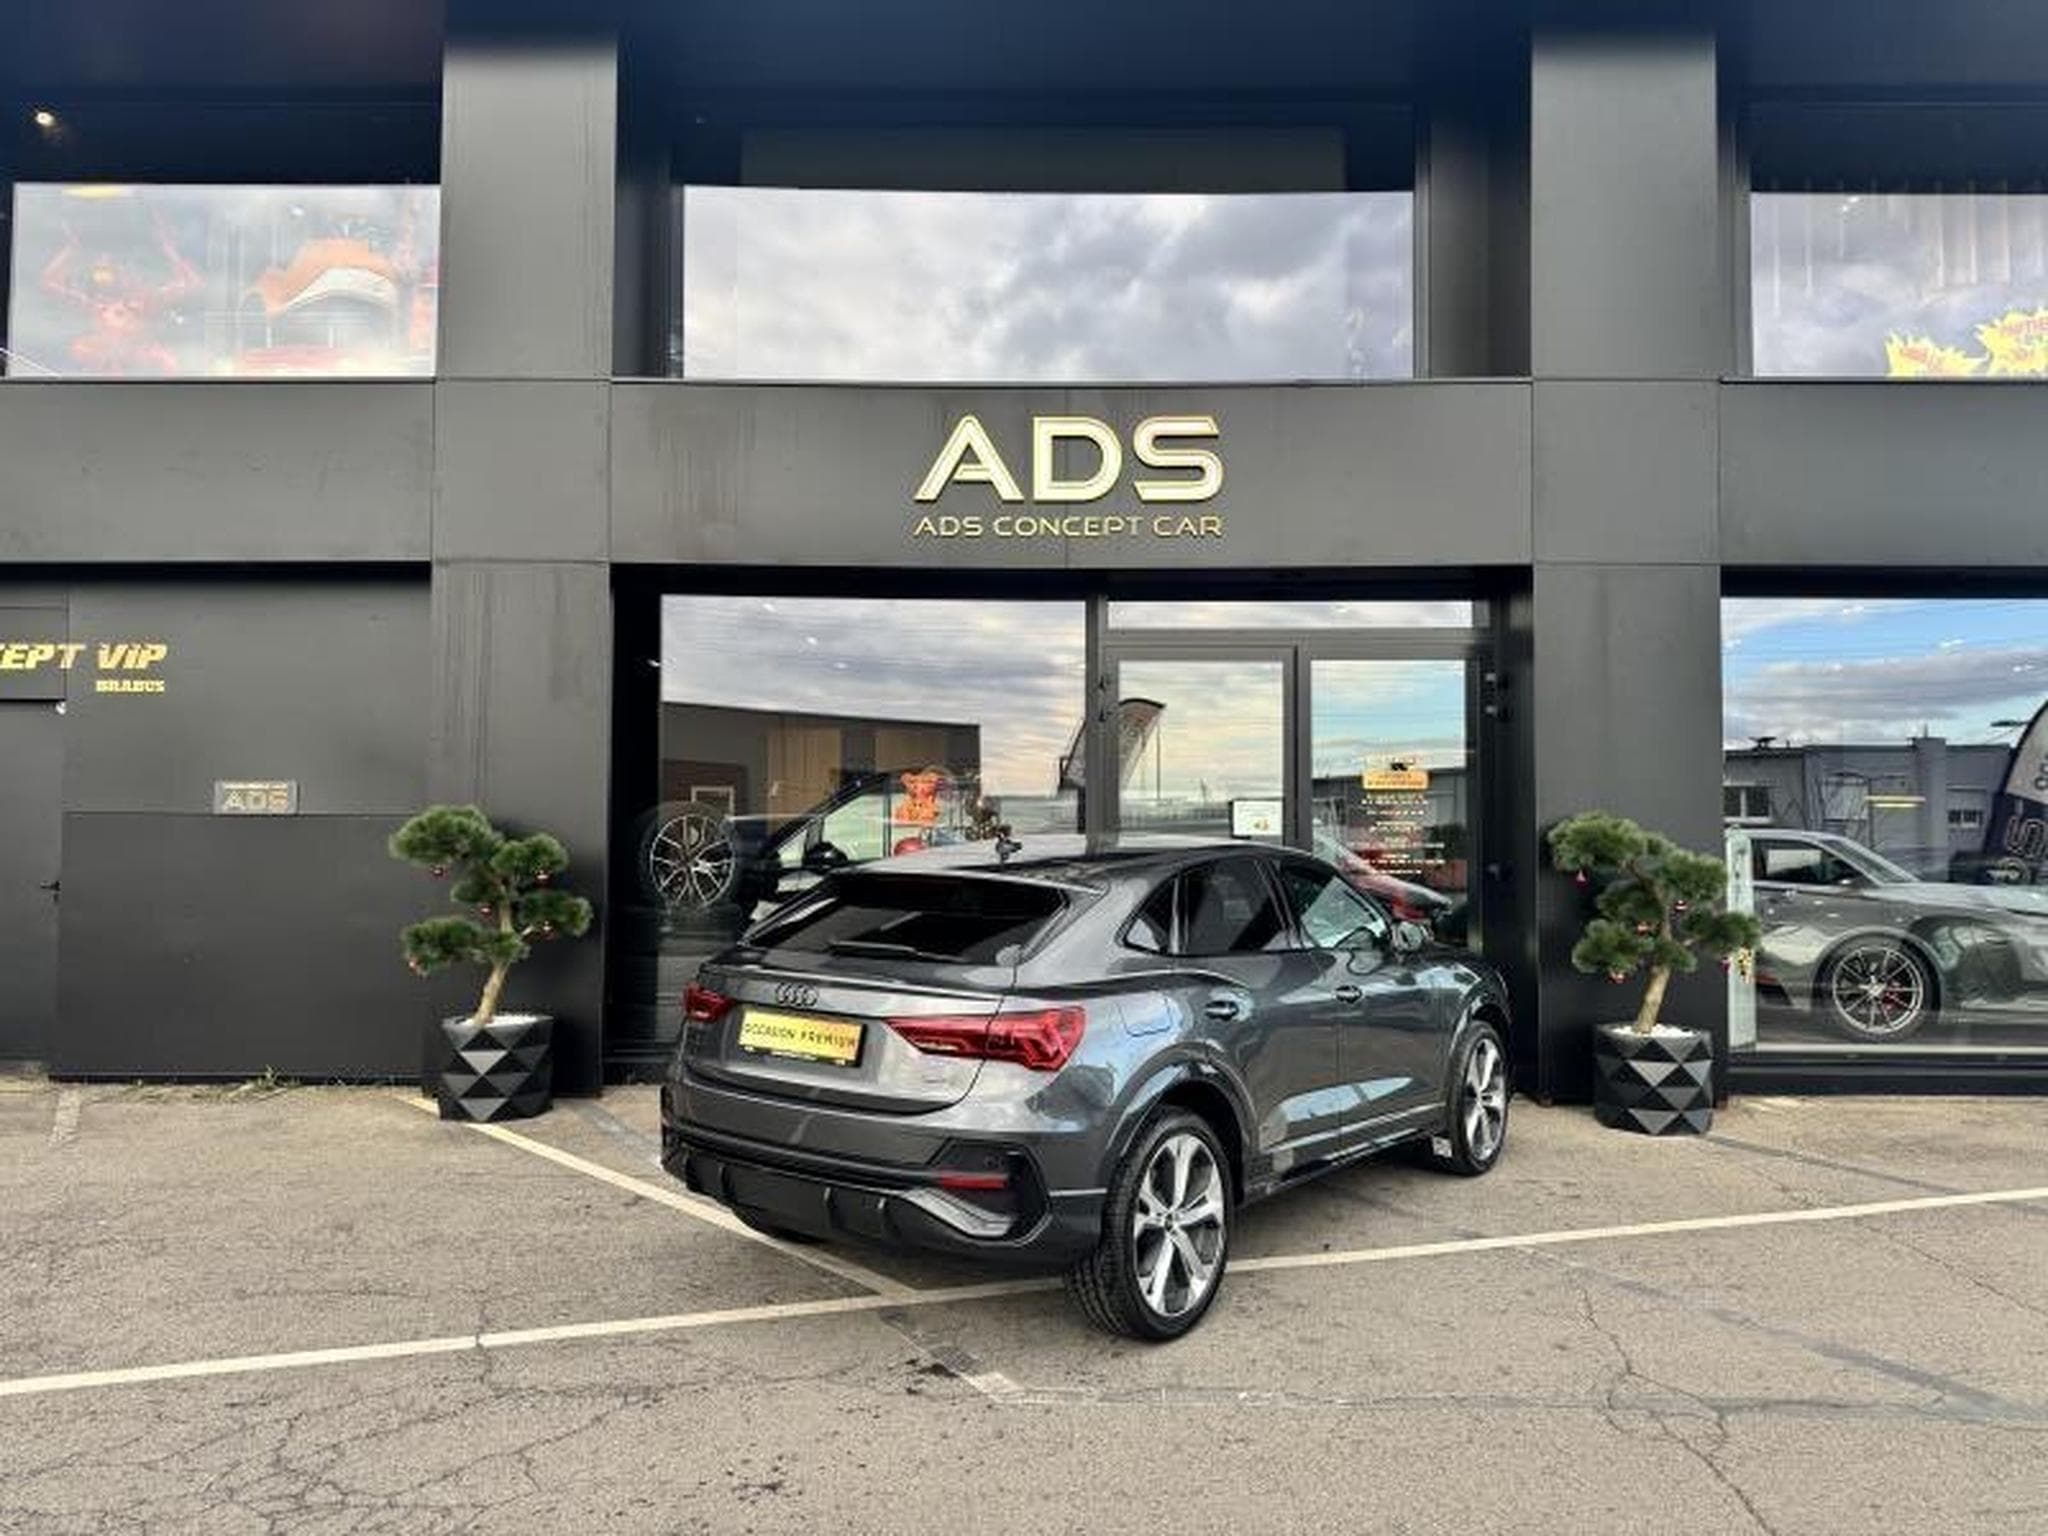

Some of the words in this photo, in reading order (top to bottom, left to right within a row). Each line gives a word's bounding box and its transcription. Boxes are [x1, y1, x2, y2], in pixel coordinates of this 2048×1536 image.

[913, 414, 1225, 502] ADS
[914, 516, 984, 537] ADS
[993, 516, 1144, 537] CONCEPT
[1153, 516, 1224, 537] CAR
[222, 790, 289, 812] ADS
[800, 1031, 857, 1049] PREMIUM
